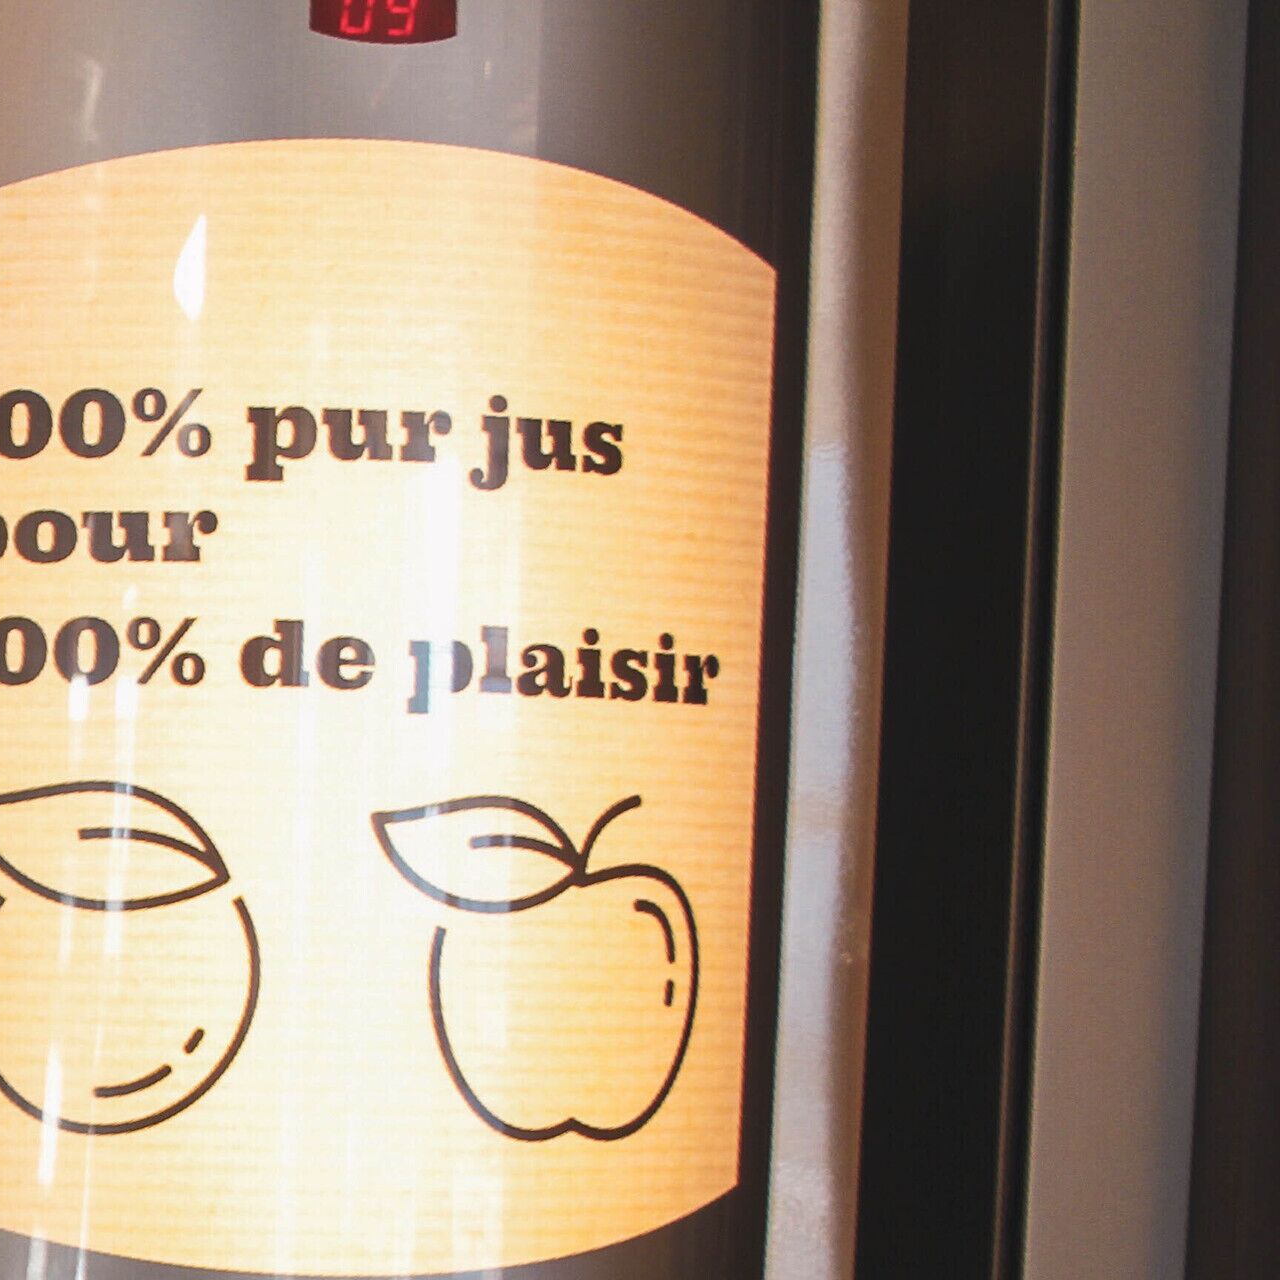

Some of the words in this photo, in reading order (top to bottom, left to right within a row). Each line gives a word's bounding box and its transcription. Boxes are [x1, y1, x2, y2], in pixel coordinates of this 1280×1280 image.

[244, 402, 452, 482] pur
[470, 395, 624, 491] jus
[239, 618, 377, 691] de
[405, 624, 722, 715] plaisir
